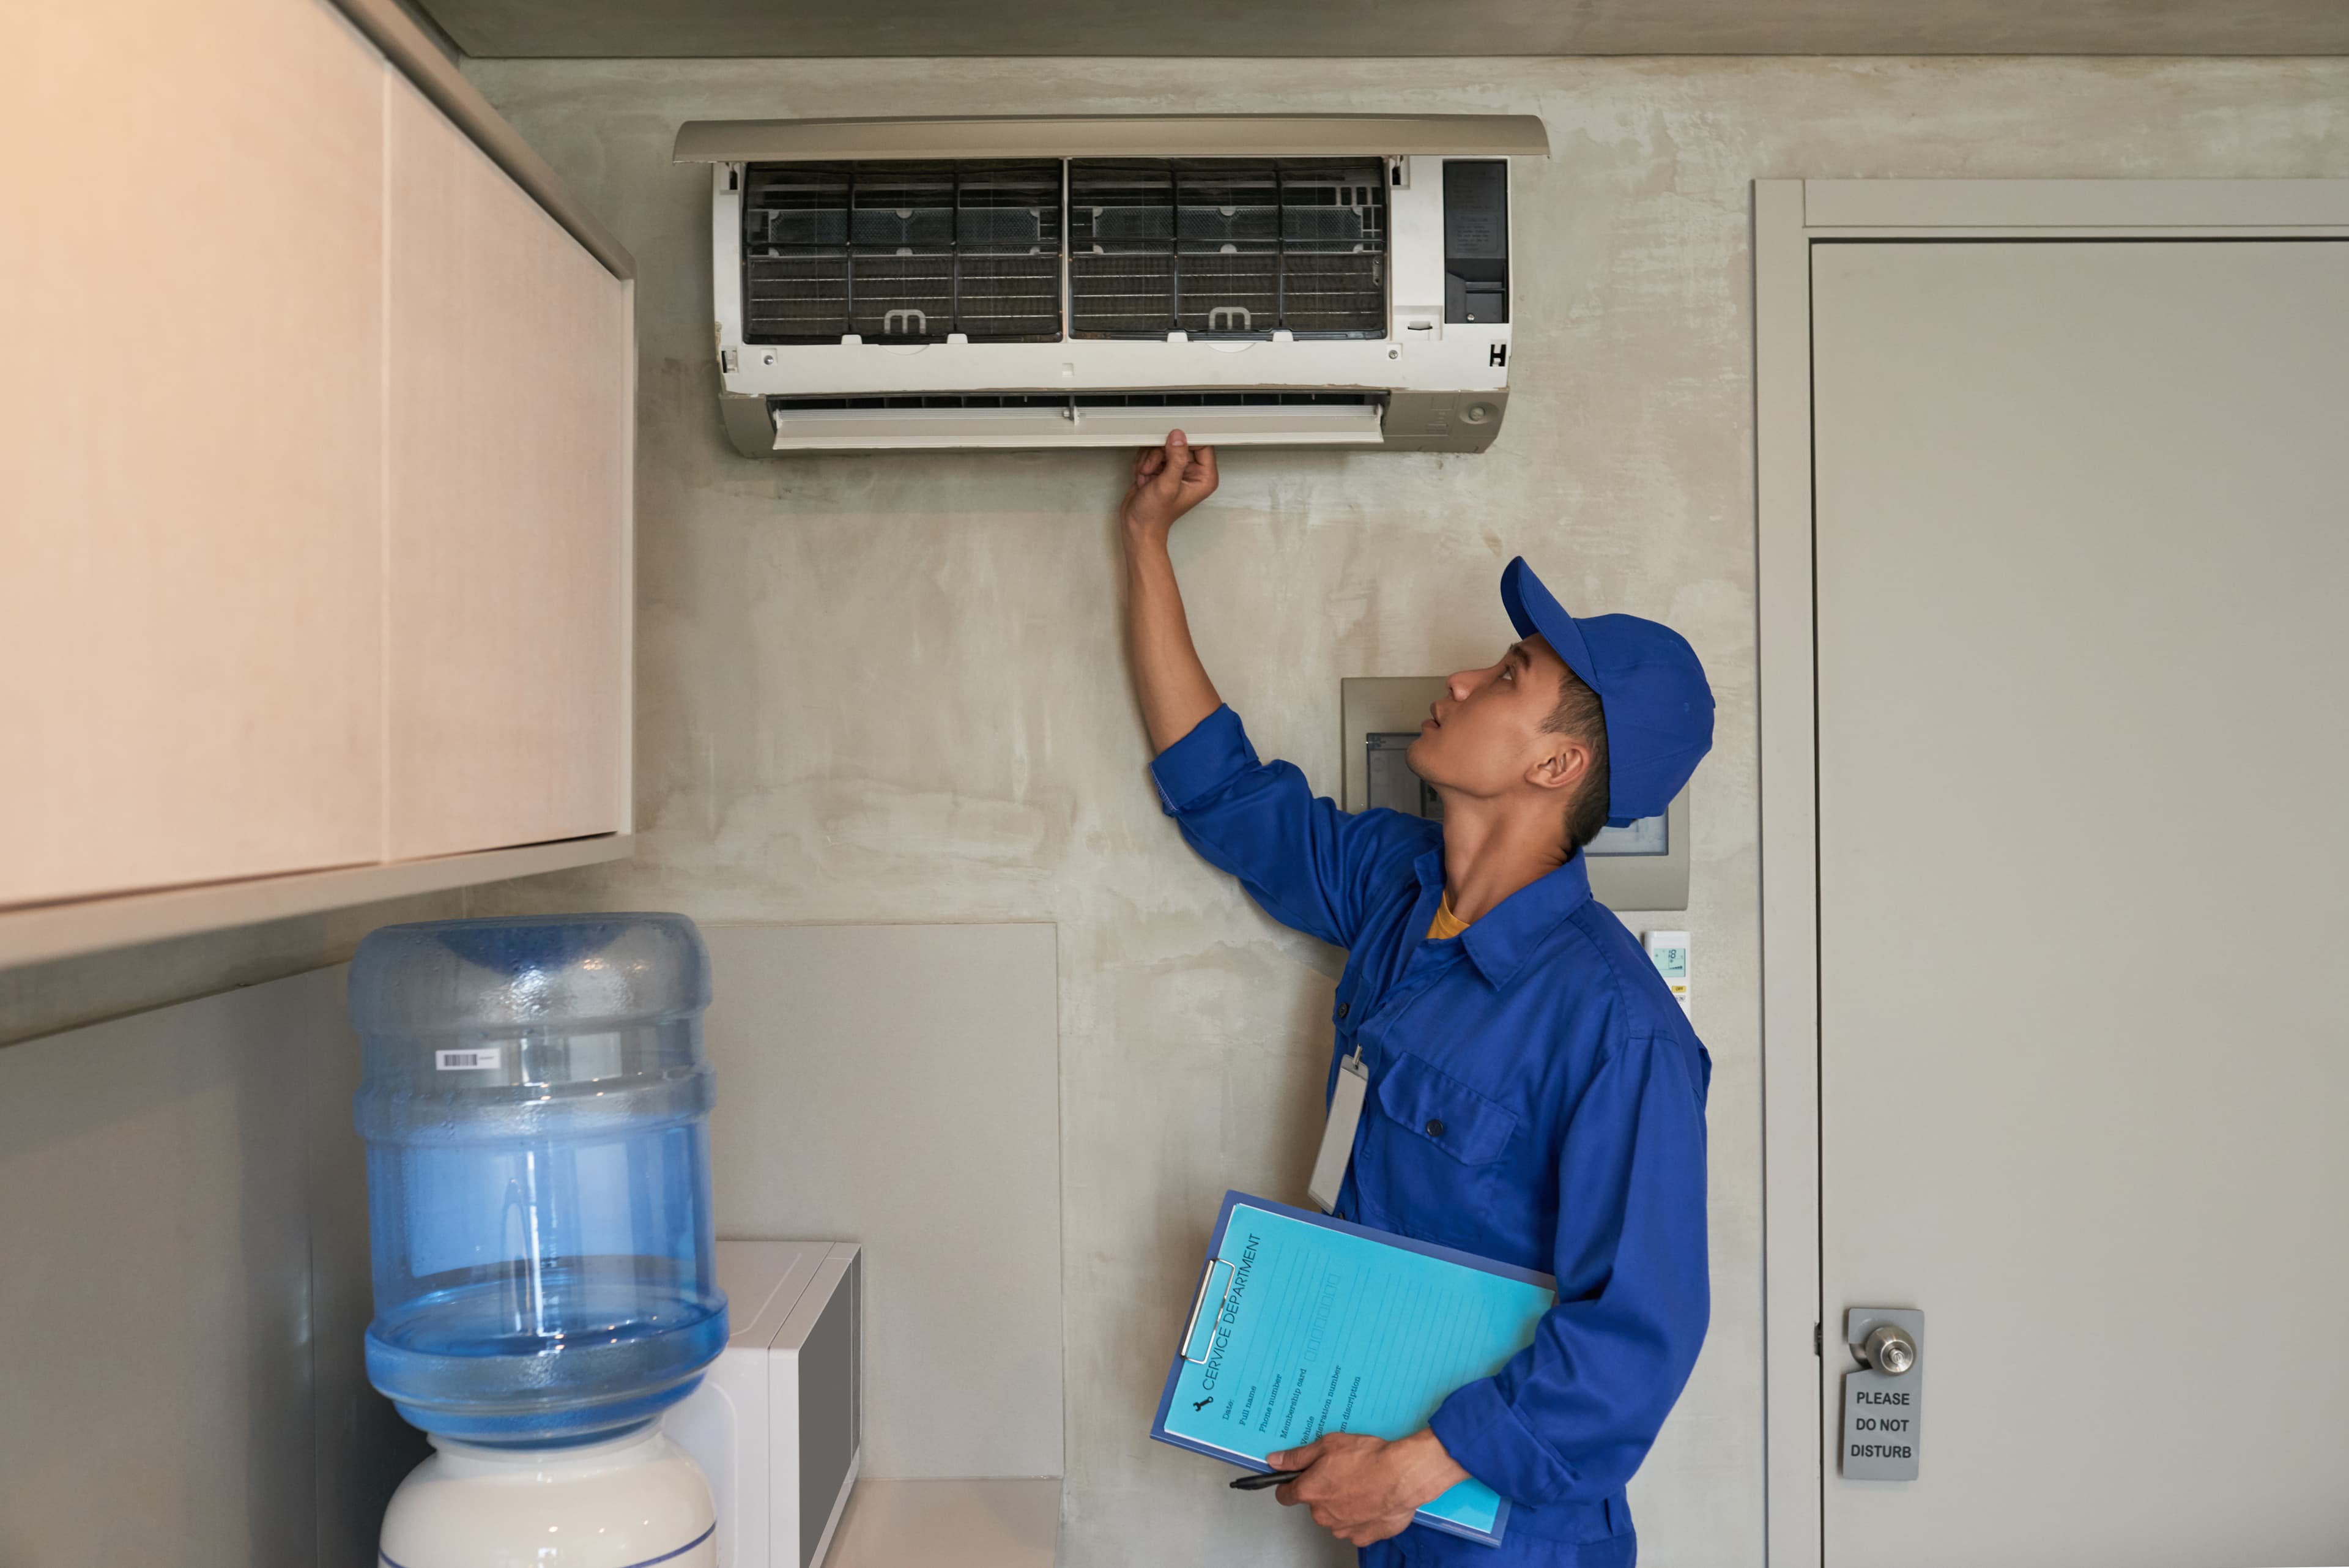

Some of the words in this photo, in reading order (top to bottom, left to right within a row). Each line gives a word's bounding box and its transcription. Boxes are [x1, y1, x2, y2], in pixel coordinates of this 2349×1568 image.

[1202, 1326, 1231, 1391] CERVICE
[1223, 1233, 1261, 1325] DEPARTMENT
[1223, 1399, 1234, 1421] Date:
[1239, 1410, 1250, 1427] Full
[1245, 1386, 1256, 1409] name
[1258, 1407, 1272, 1433] Phone
[1268, 1373, 1282, 1406] number
[1280, 1388, 1302, 1439] Membership
[1297, 1368, 1307, 1388] card
[1315, 1399, 1332, 1441] gistration
[1327, 1365, 1341, 1398] number
[1342, 1377, 1361, 1421] discription
[1857, 1392, 1910, 1405] PLEASE
[1301, 1416, 1315, 1445] Vehicle
[1856, 1418, 1876, 1431] DO
[1880, 1419, 1909, 1432] NOT
[1850, 1444, 1912, 1458] DISTURB
